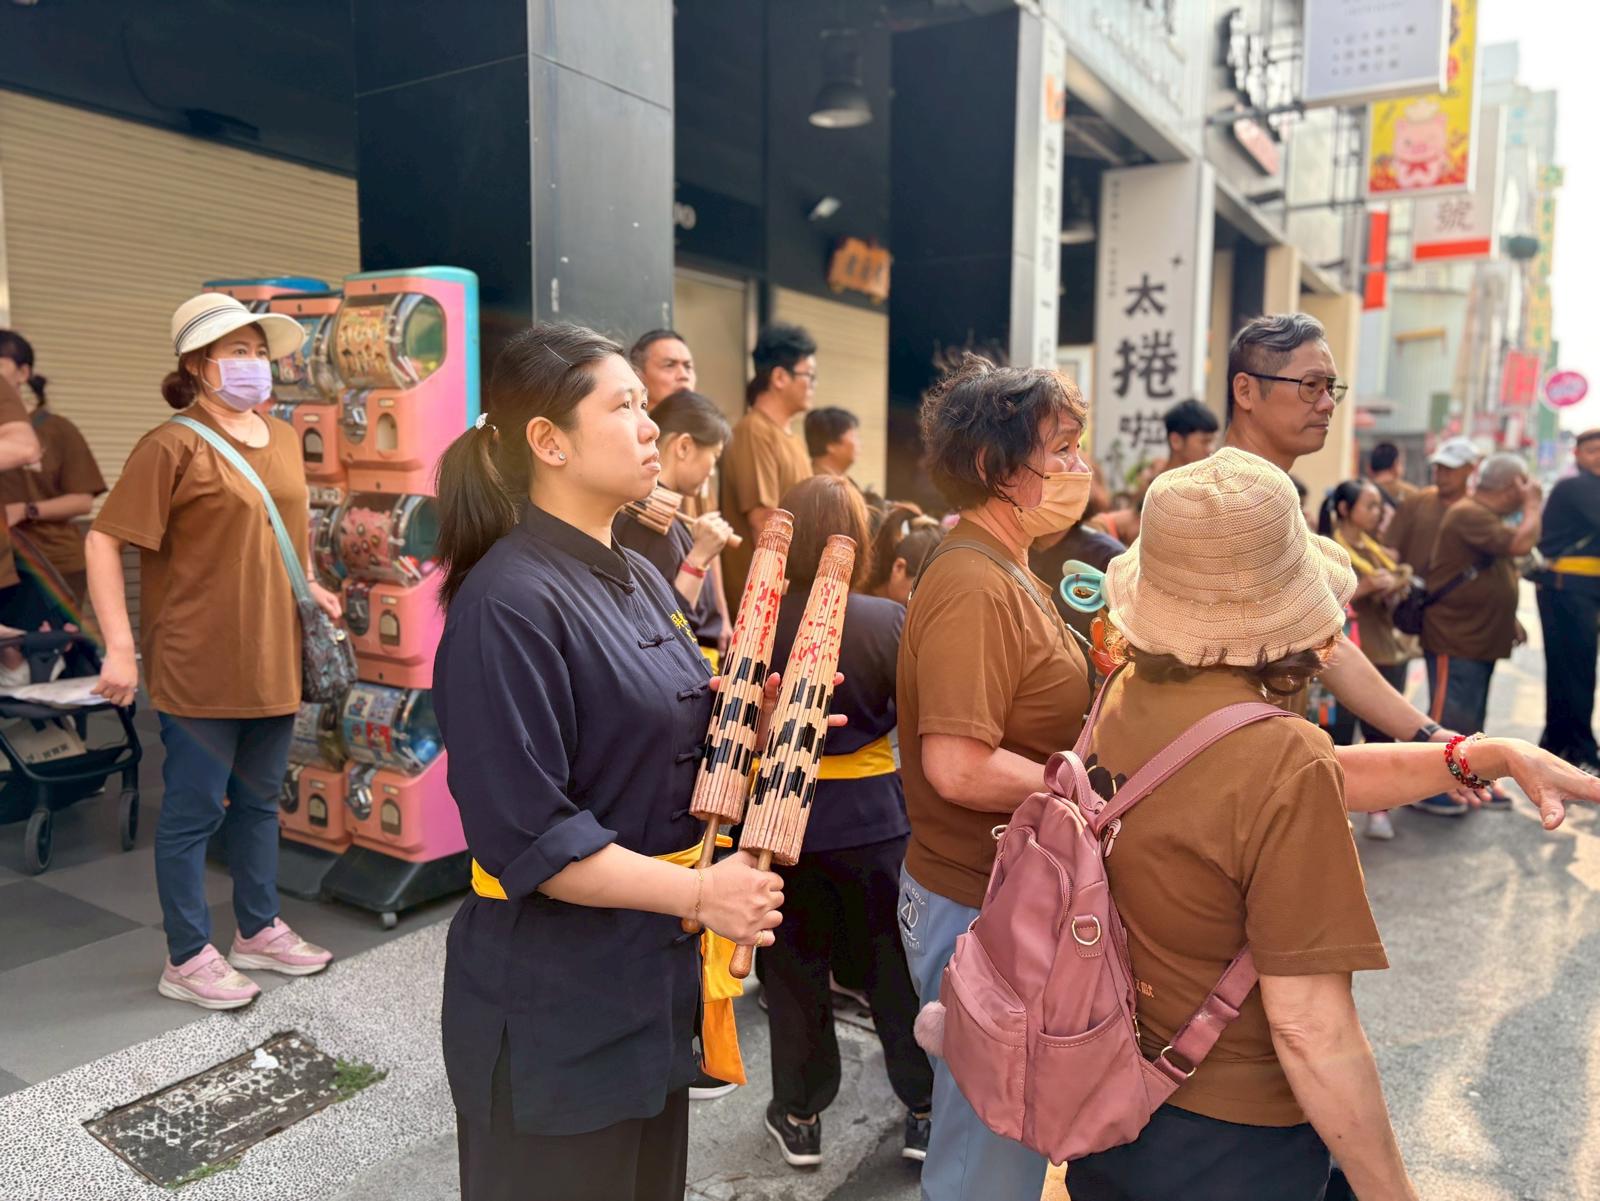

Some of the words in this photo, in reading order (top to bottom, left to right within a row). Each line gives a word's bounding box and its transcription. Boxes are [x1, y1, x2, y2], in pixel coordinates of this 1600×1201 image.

[1436, 199, 1474, 232] 號
[1112, 272, 1178, 448] 太捲啦
